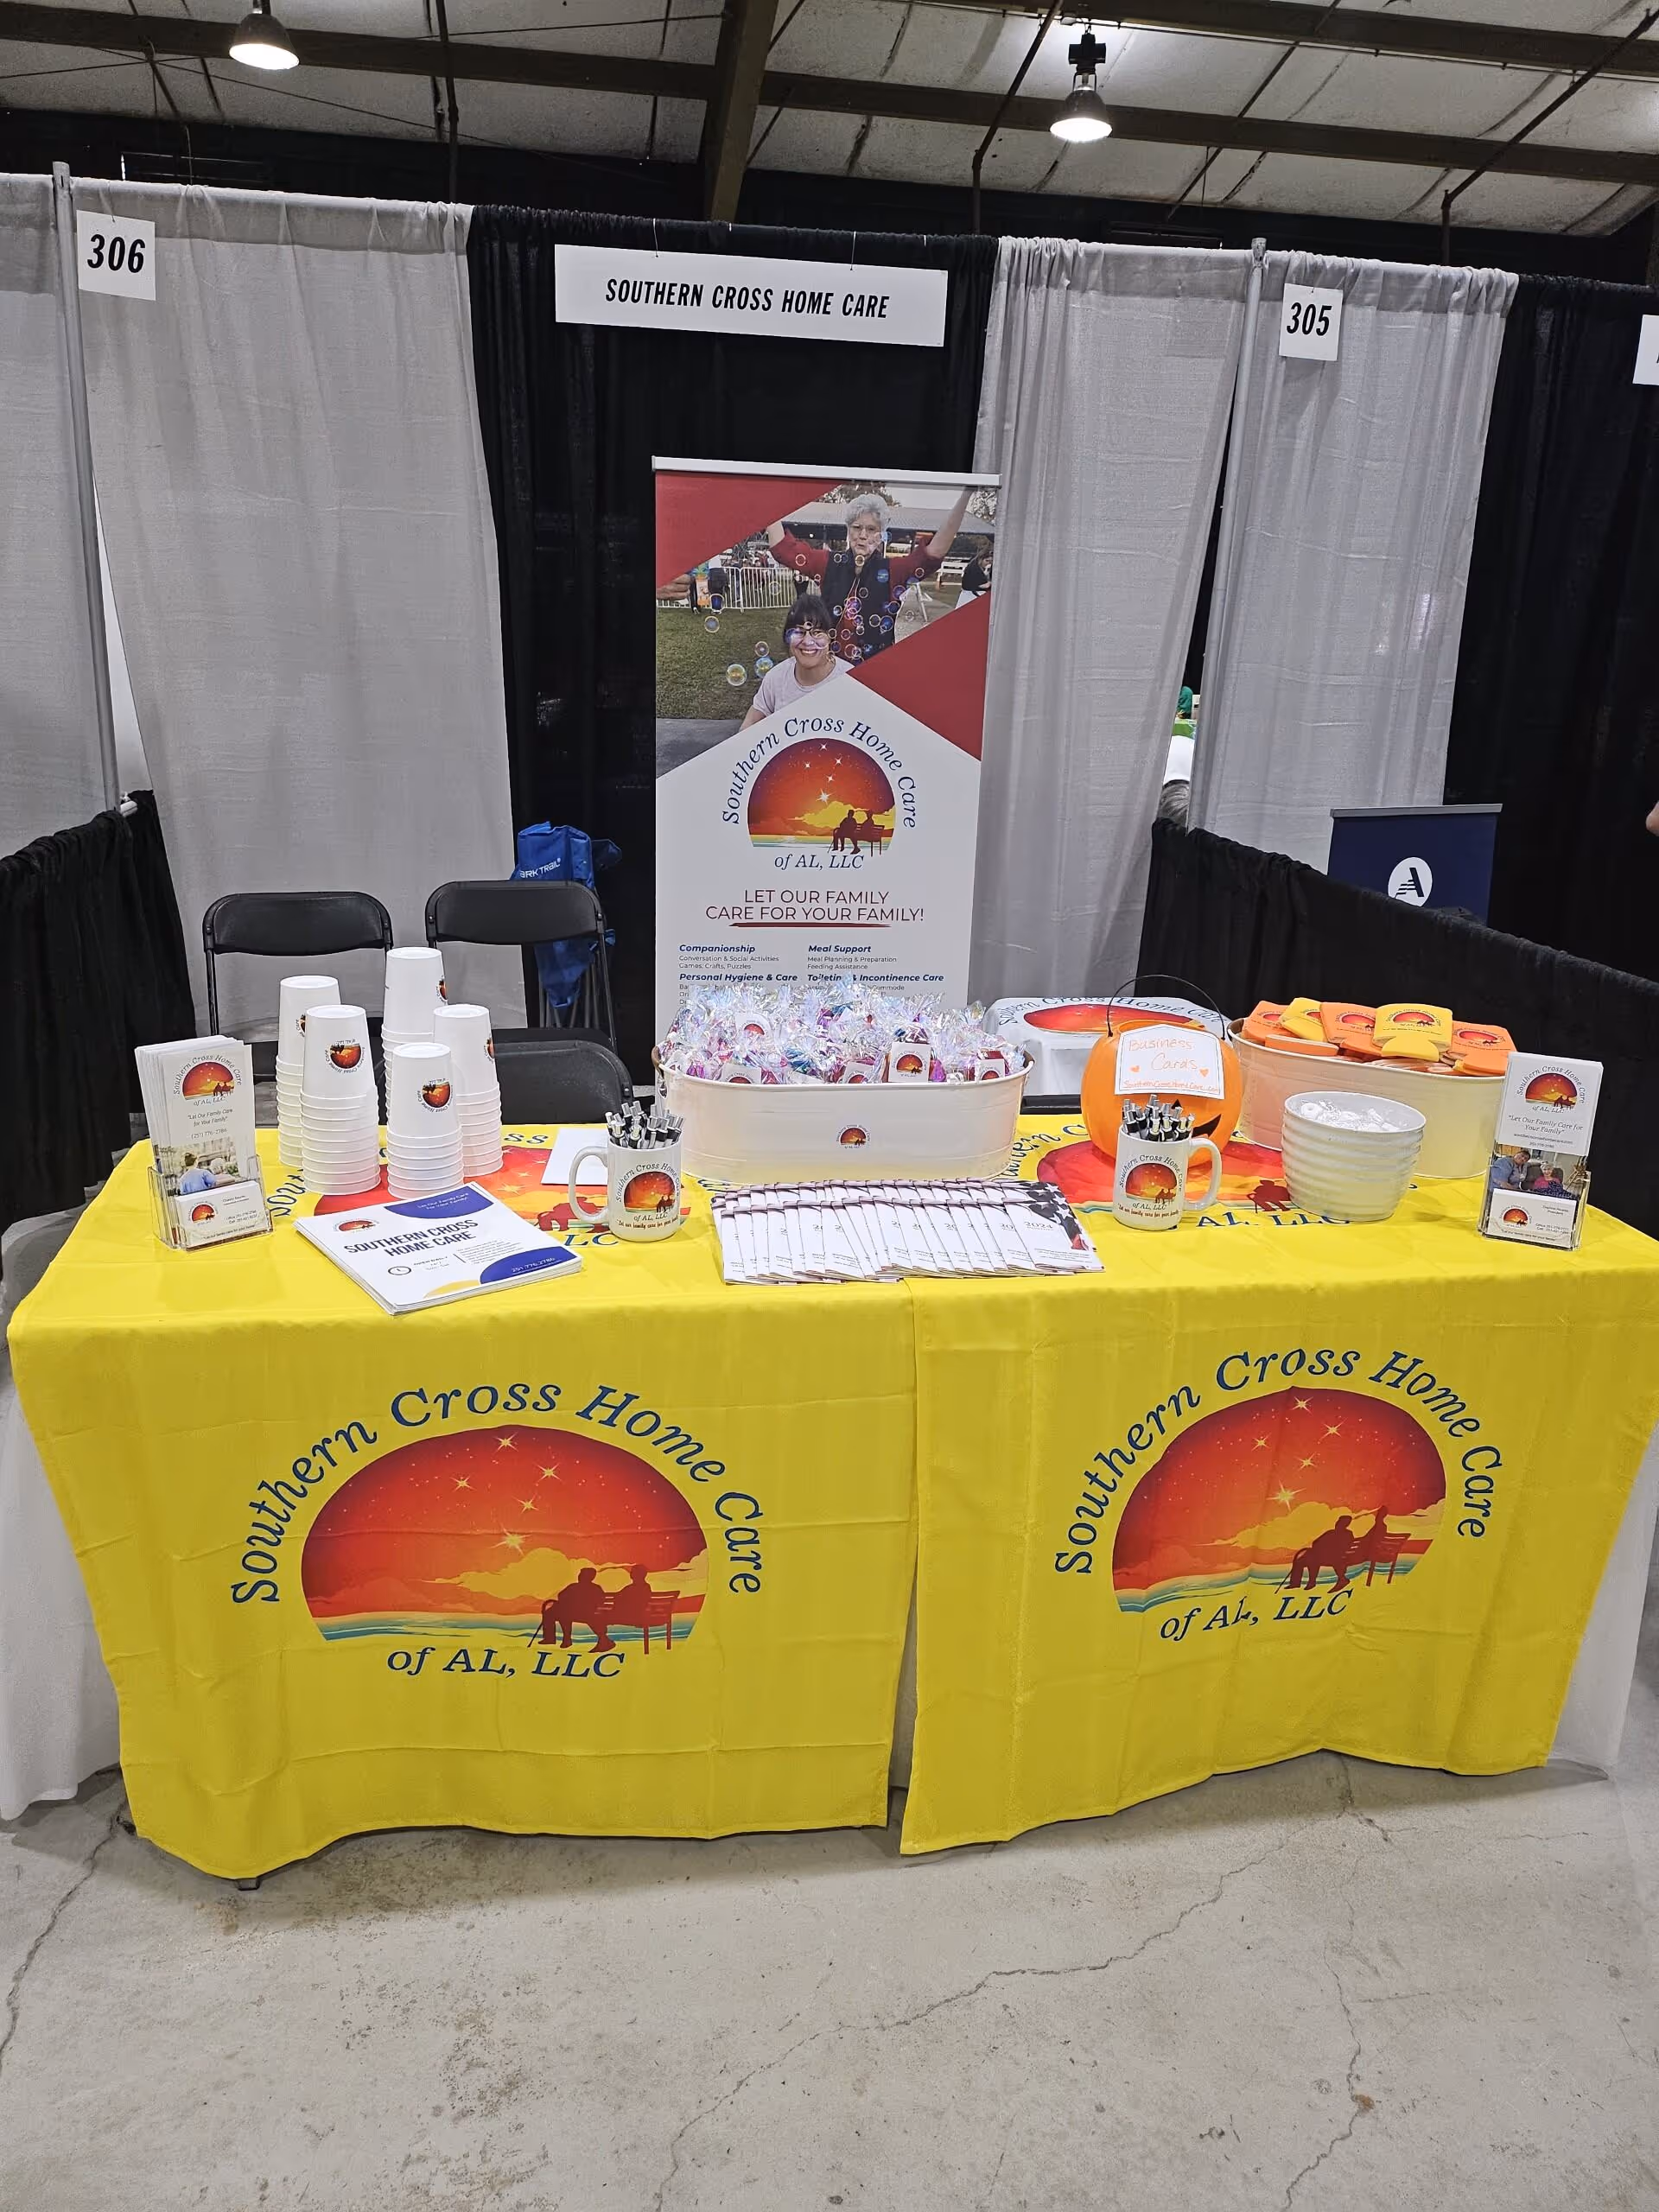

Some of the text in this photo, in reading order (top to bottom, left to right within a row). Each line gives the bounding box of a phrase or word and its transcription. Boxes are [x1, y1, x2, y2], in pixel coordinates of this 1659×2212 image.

[87, 233, 145, 273] 306
[606, 278, 890, 318] SOUTHERN CROSS HOME CARE
[1286, 302, 1332, 336] 305
[722, 717, 917, 828] Southern Cross Home Care
[774, 854, 864, 870] of AL, LLC
[744, 889, 889, 905] LET OUR FAMILY
[705, 906, 924, 922] CARE FOR YOUR FAMILY!
[679, 944, 756, 955] Companionship
[834, 945, 872, 954] Support
[679, 973, 722, 982] Personal
[725, 973, 764, 982] Hygiene
[192, 1055, 213, 1065] Cross
[214, 1054, 234, 1069] Home
[233, 1068, 242, 1085] Care
[1516, 1069, 1541, 1096] Southern
[1564, 1069, 1582, 1086] Home
[615, 1169, 635, 1202] Southern
[635, 1163, 659, 1173] Cross
[660, 1163, 677, 1178] Home
[1119, 1158, 1138, 1188] Southern
[1163, 1156, 1180, 1173] Home
[655, 1211, 669, 1220] LLC
[343, 1219, 479, 1254] SOUTHERN CROSS
[383, 1240, 435, 1257] HOME
[433, 1230, 477, 1248] CARE
[1055, 1348, 1503, 1574] Southern Cross Home Care
[231, 1382, 765, 1605] Southern Cross Home Care
[1160, 1588, 1354, 1642] of AL, LLC
[386, 1646, 626, 1681] of AL, LLC
